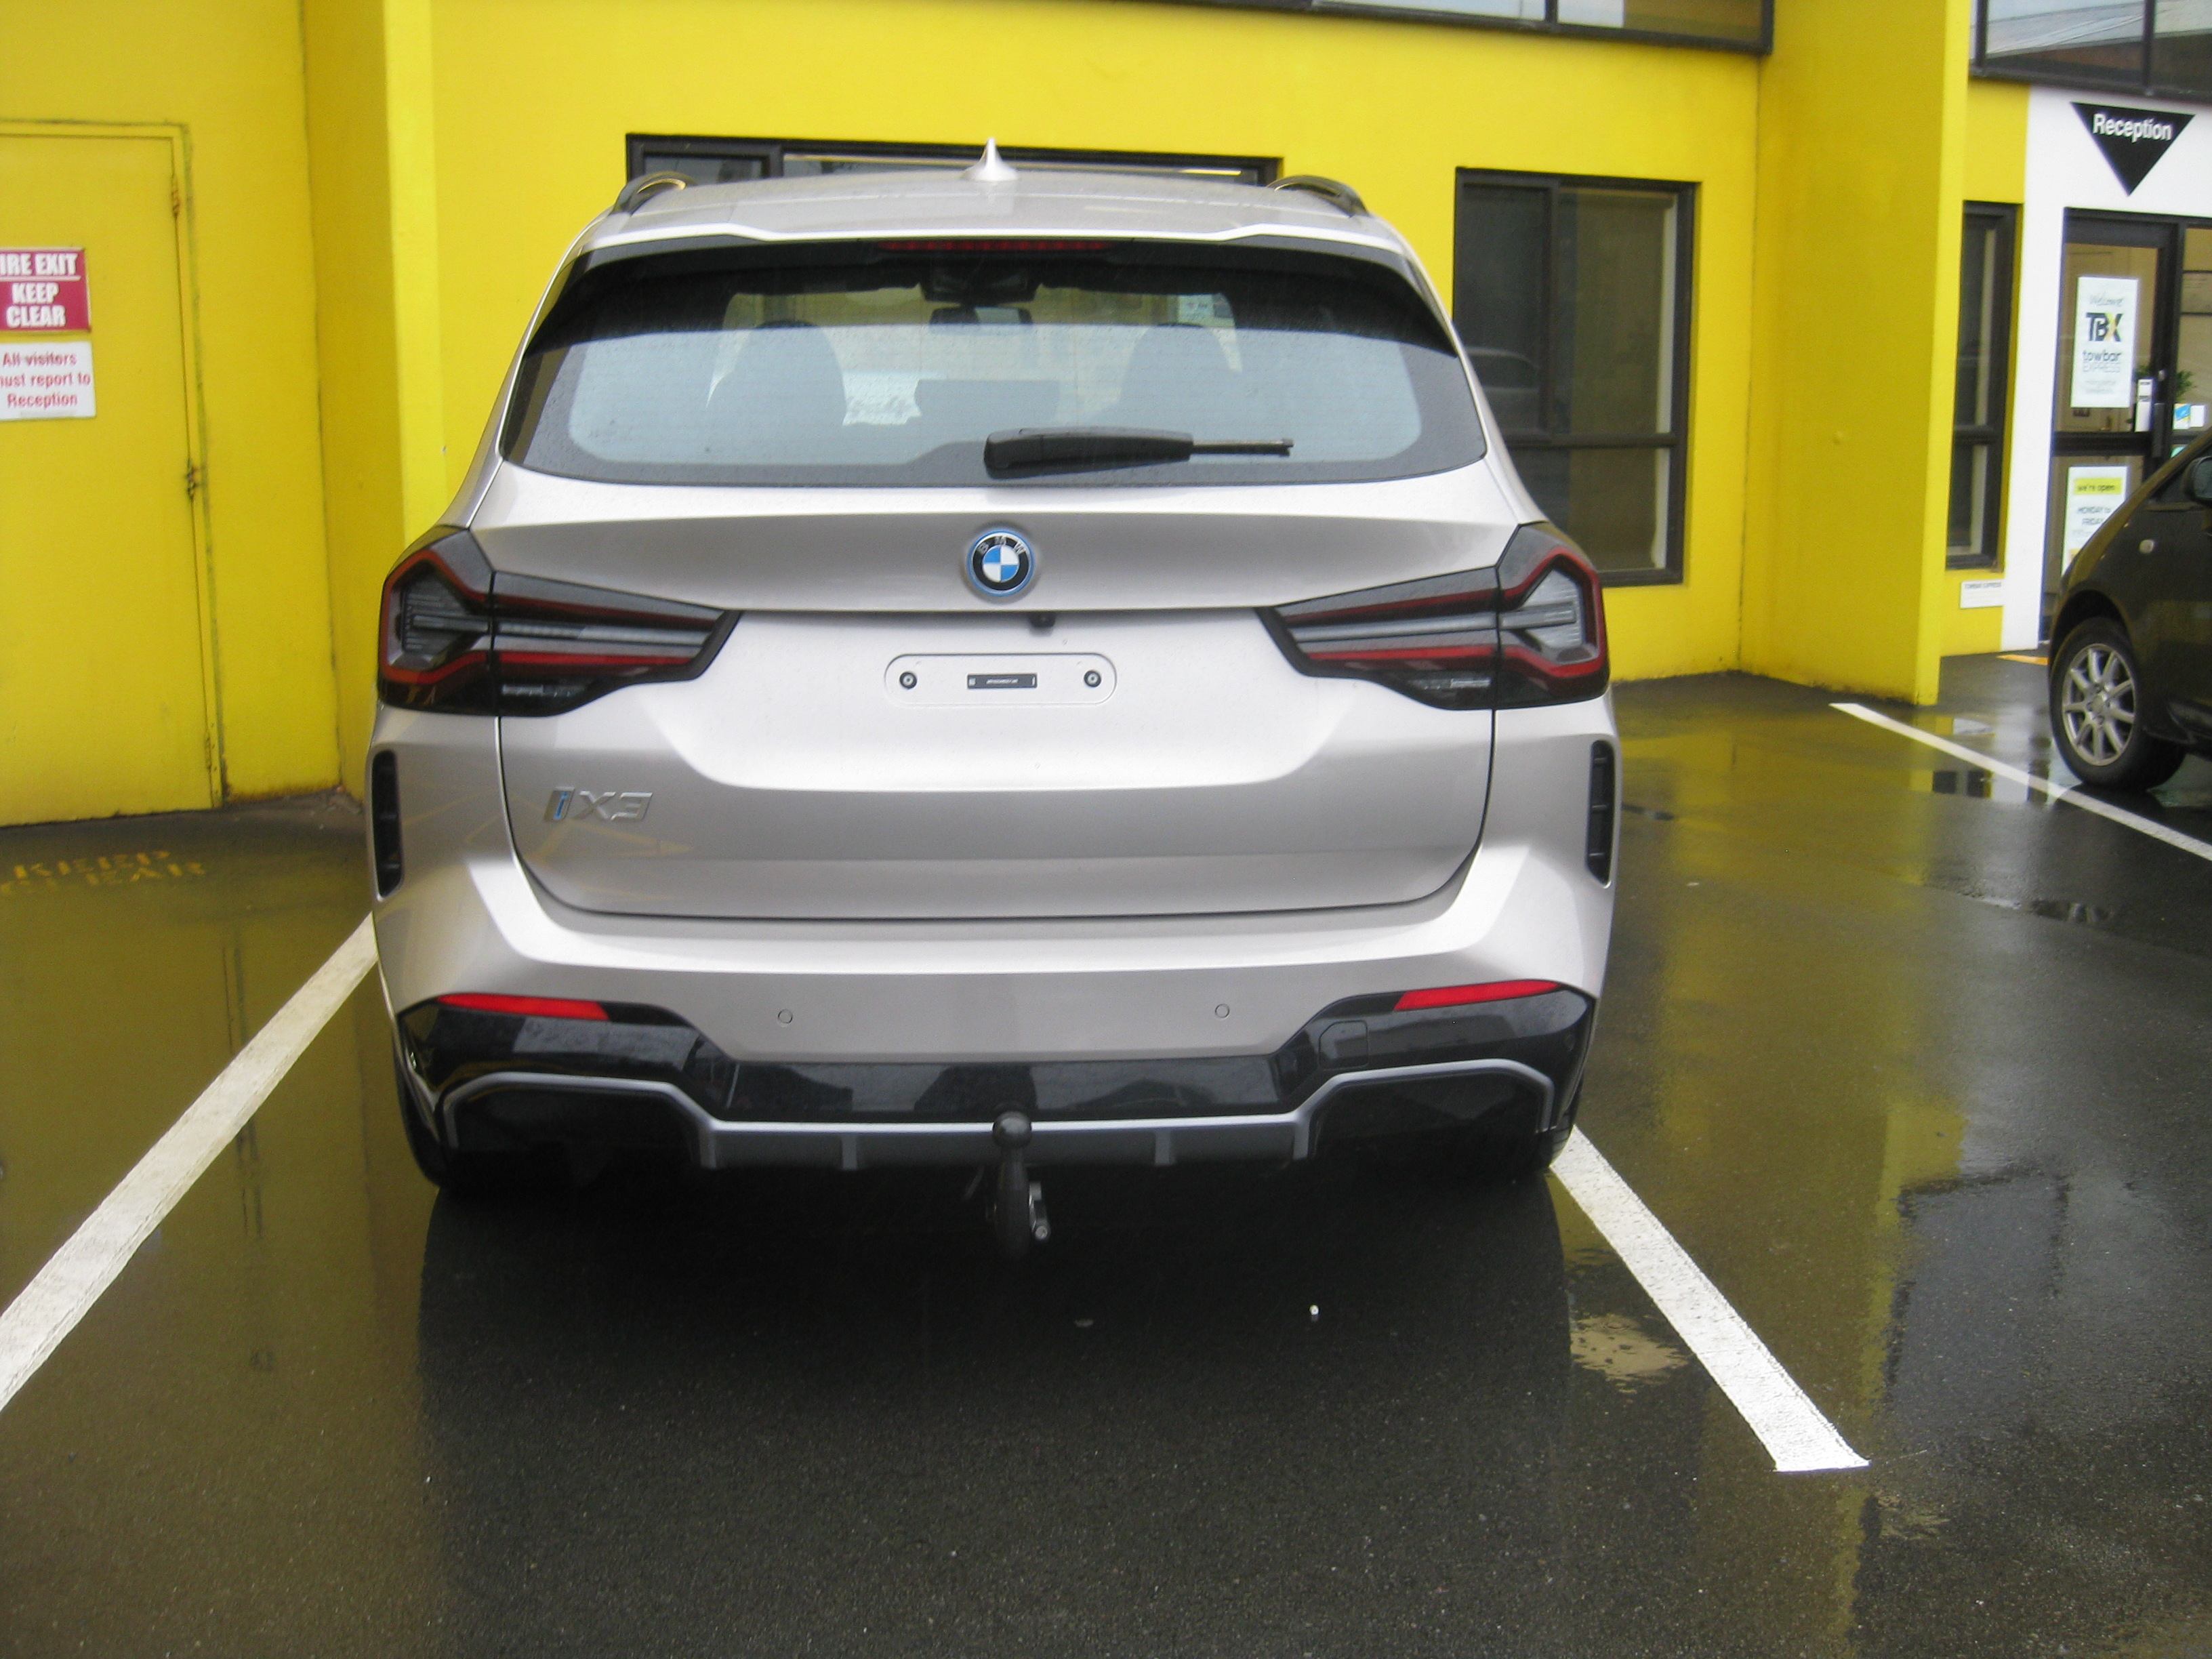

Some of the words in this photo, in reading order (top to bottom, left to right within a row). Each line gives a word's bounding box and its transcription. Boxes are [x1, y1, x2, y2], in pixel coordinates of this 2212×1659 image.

[2093, 113, 2173, 143] Reception
[35, 253, 79, 275] EXIT
[12, 282, 60, 304] KEEP
[6, 305, 66, 328] CLEAR
[2086, 312, 2123, 342] TBX
[3, 352, 21, 366] All
[24, 352, 77, 366] visitors
[2083, 350, 2122, 362] towbar
[31, 373, 73, 392] report
[78, 372, 91, 385] to
[7, 392, 78, 409] Reception
[975, 535, 1027, 555] BMW
